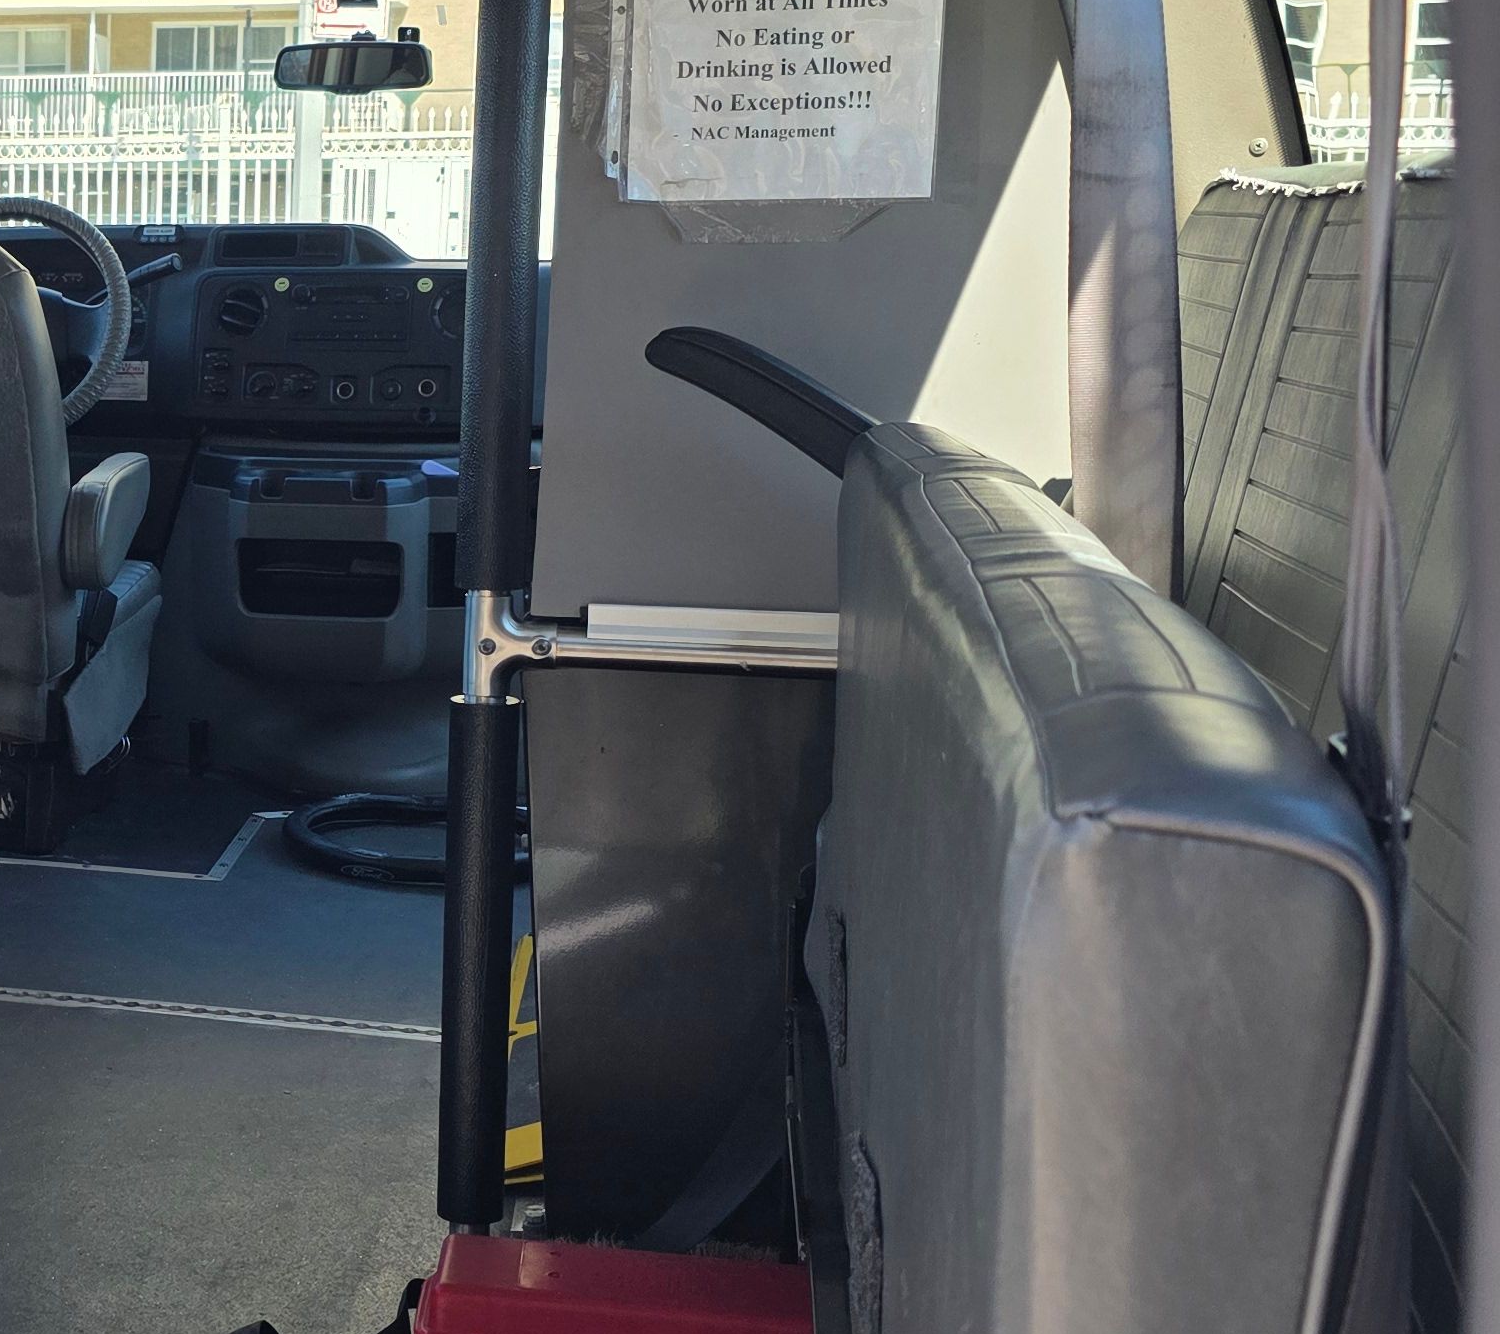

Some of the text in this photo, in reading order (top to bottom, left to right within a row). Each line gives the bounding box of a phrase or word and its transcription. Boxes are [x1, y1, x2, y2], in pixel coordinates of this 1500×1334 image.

[715, 27, 855, 49] No Eating or
[676, 55, 892, 82] Drinking is Allowed
[692, 90, 872, 115] No Exceptions!!!
[690, 126, 730, 141] NAC
[734, 124, 837, 142] Management
